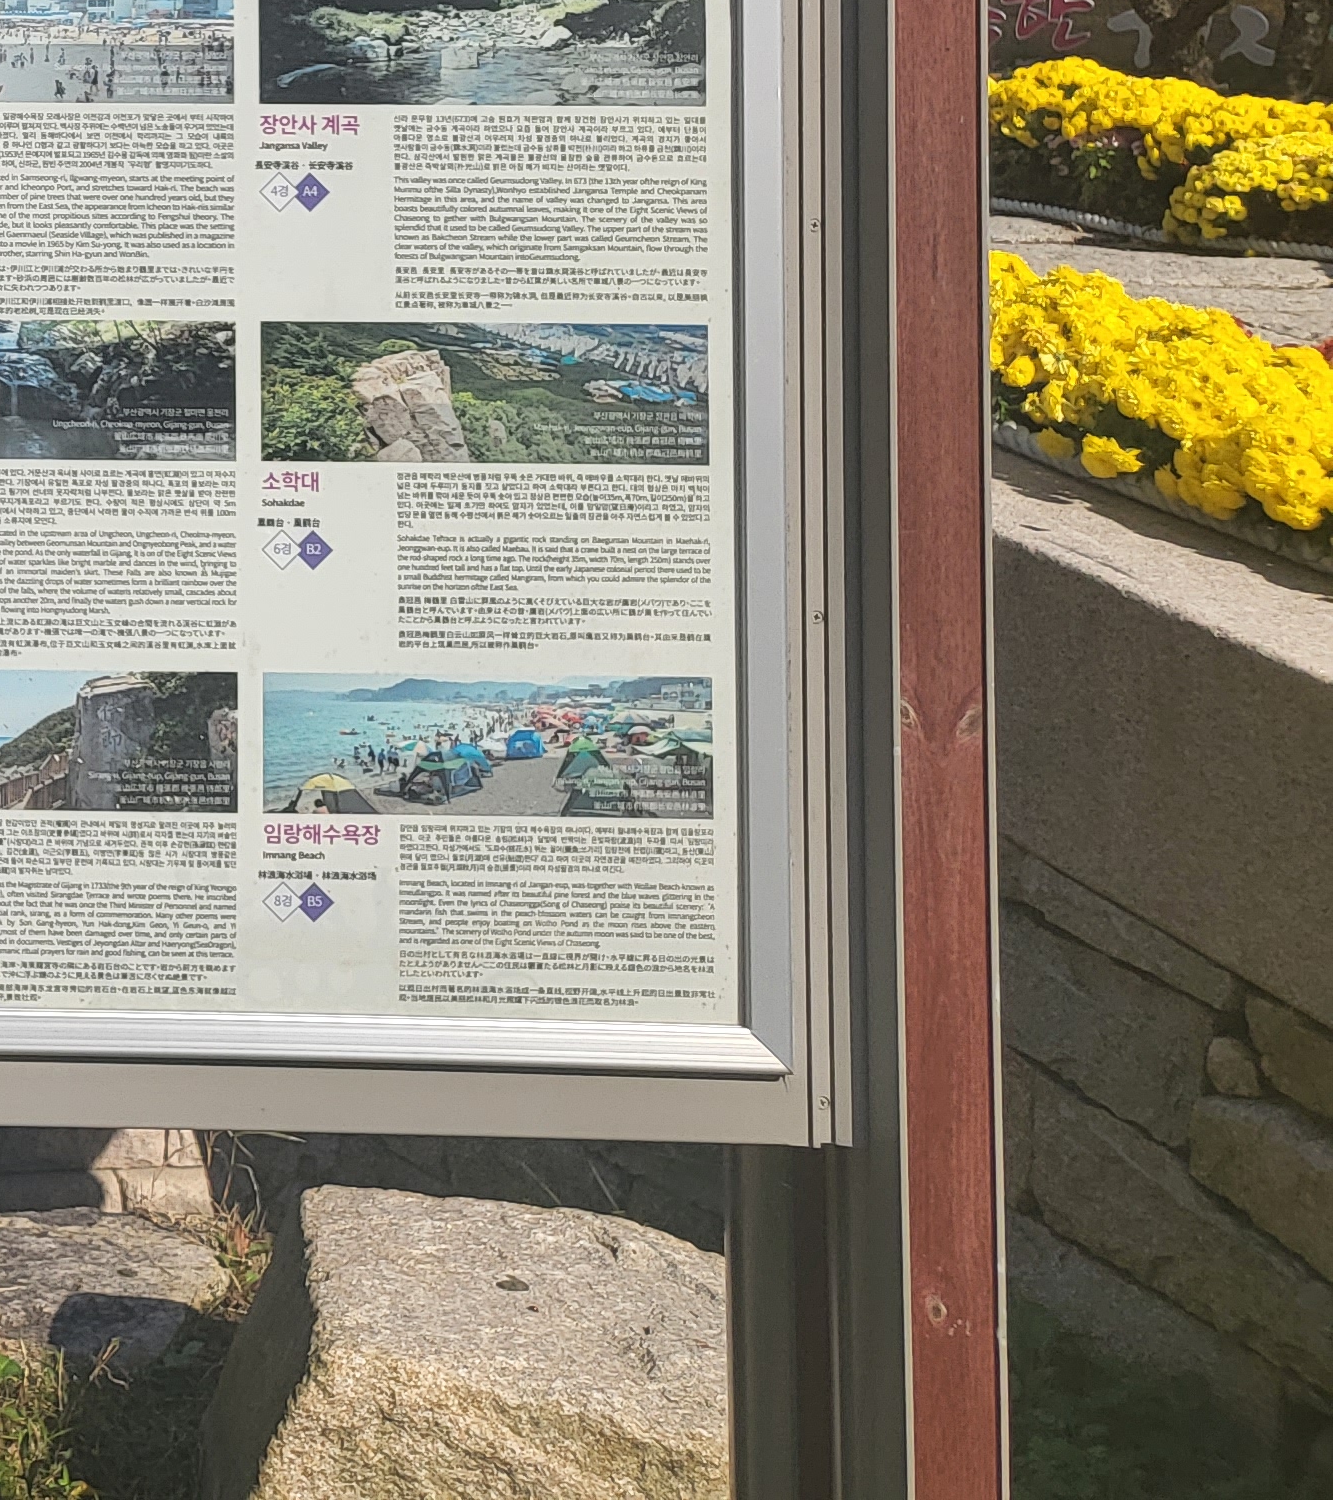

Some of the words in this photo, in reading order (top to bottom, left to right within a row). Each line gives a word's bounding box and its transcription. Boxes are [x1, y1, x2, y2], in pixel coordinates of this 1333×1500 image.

[260, 115, 317, 135] 장안사
[322, 115, 360, 135] 계곡
[259, 142, 300, 151] Jangansa
[302, 142, 328, 151] Valley
[270, 184, 290, 199] 4경
[302, 186, 318, 197] A4
[262, 471, 319, 492] 소학대
[262, 499, 305, 507] Sohakdae
[273, 541, 292, 557] 6경
[306, 543, 321, 555] B2
[264, 824, 381, 845] 임랑해수욕장
[263, 851, 297, 861] Imnang
[273, 893, 293, 909] 8경
[307, 895, 323, 906] B5
